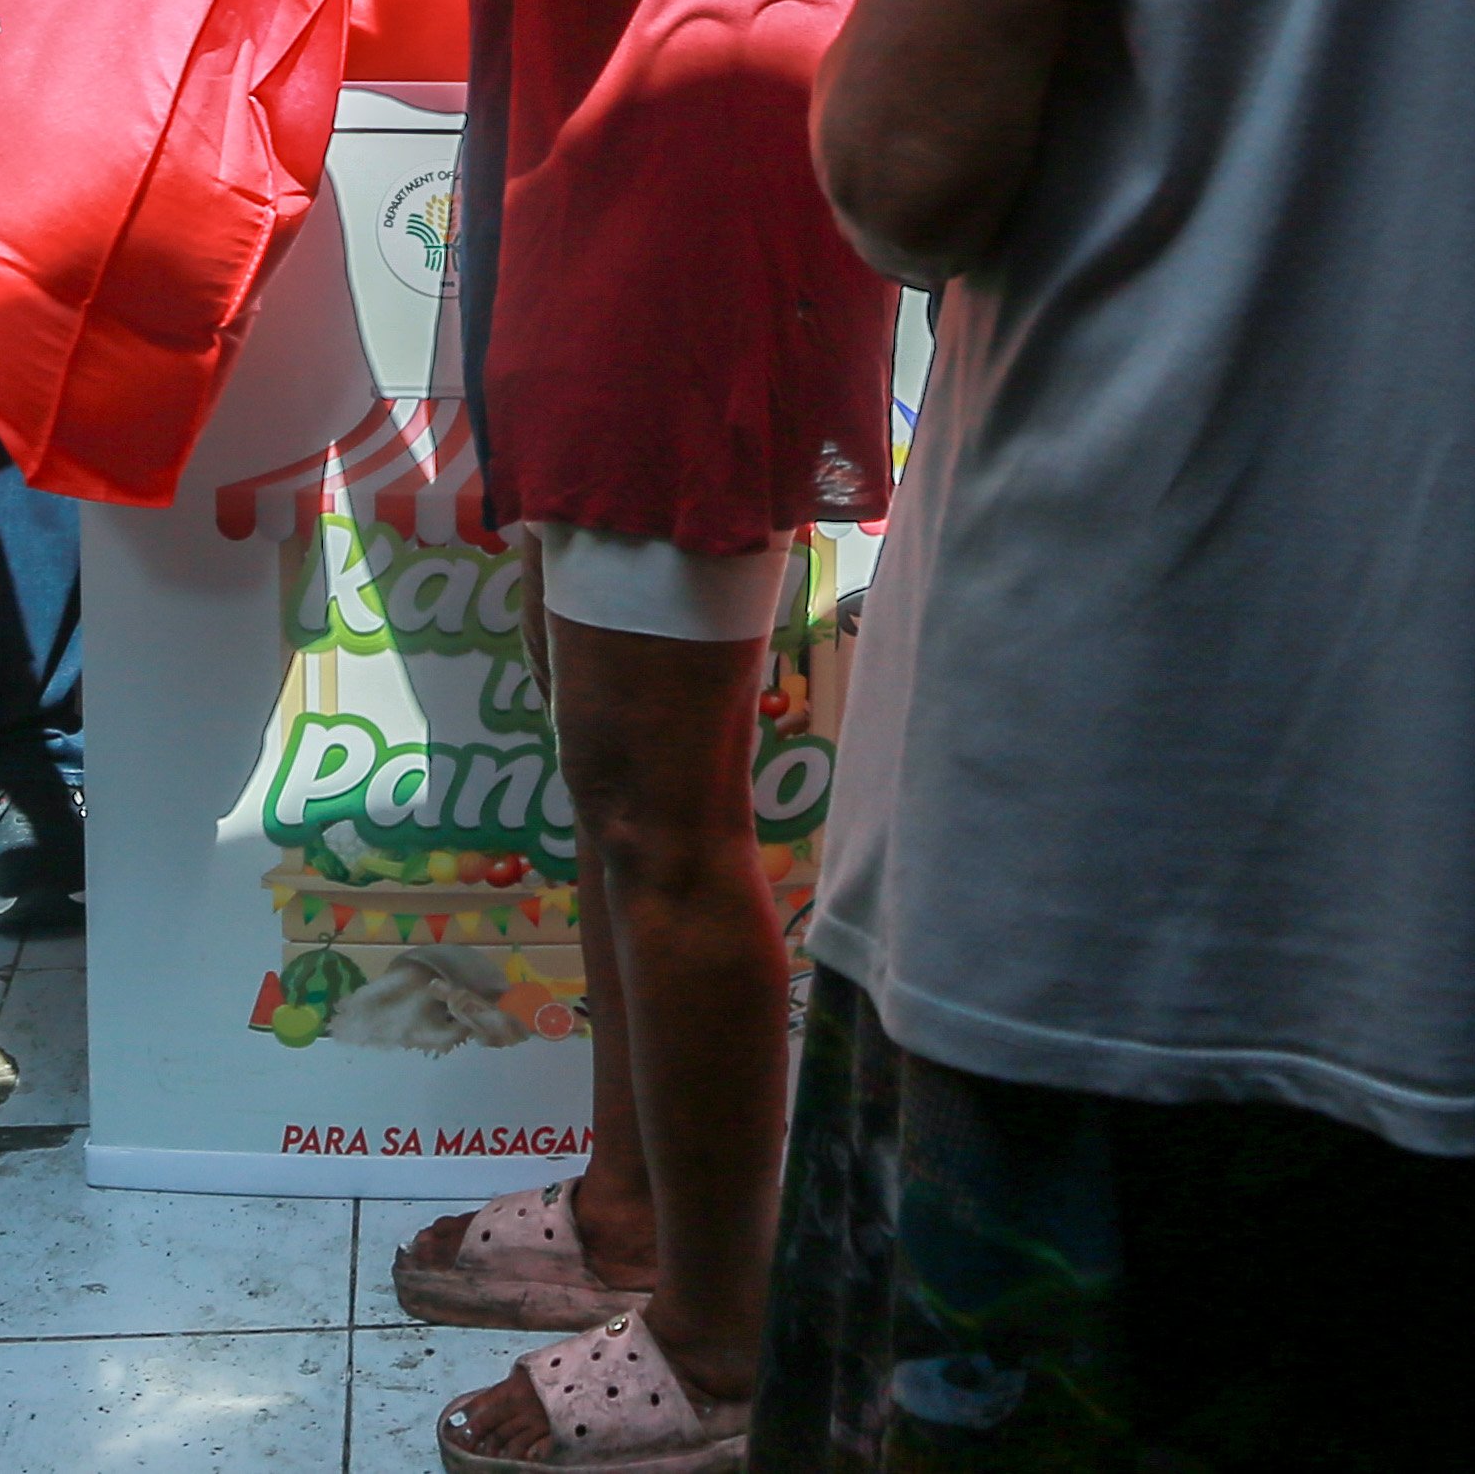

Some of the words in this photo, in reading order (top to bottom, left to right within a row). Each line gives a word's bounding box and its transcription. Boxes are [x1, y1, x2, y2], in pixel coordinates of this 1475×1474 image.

[383, 171, 435, 229] DEPARTMENT
[281, 1124, 368, 1156] PARA
[380, 1126, 423, 1156] SA
